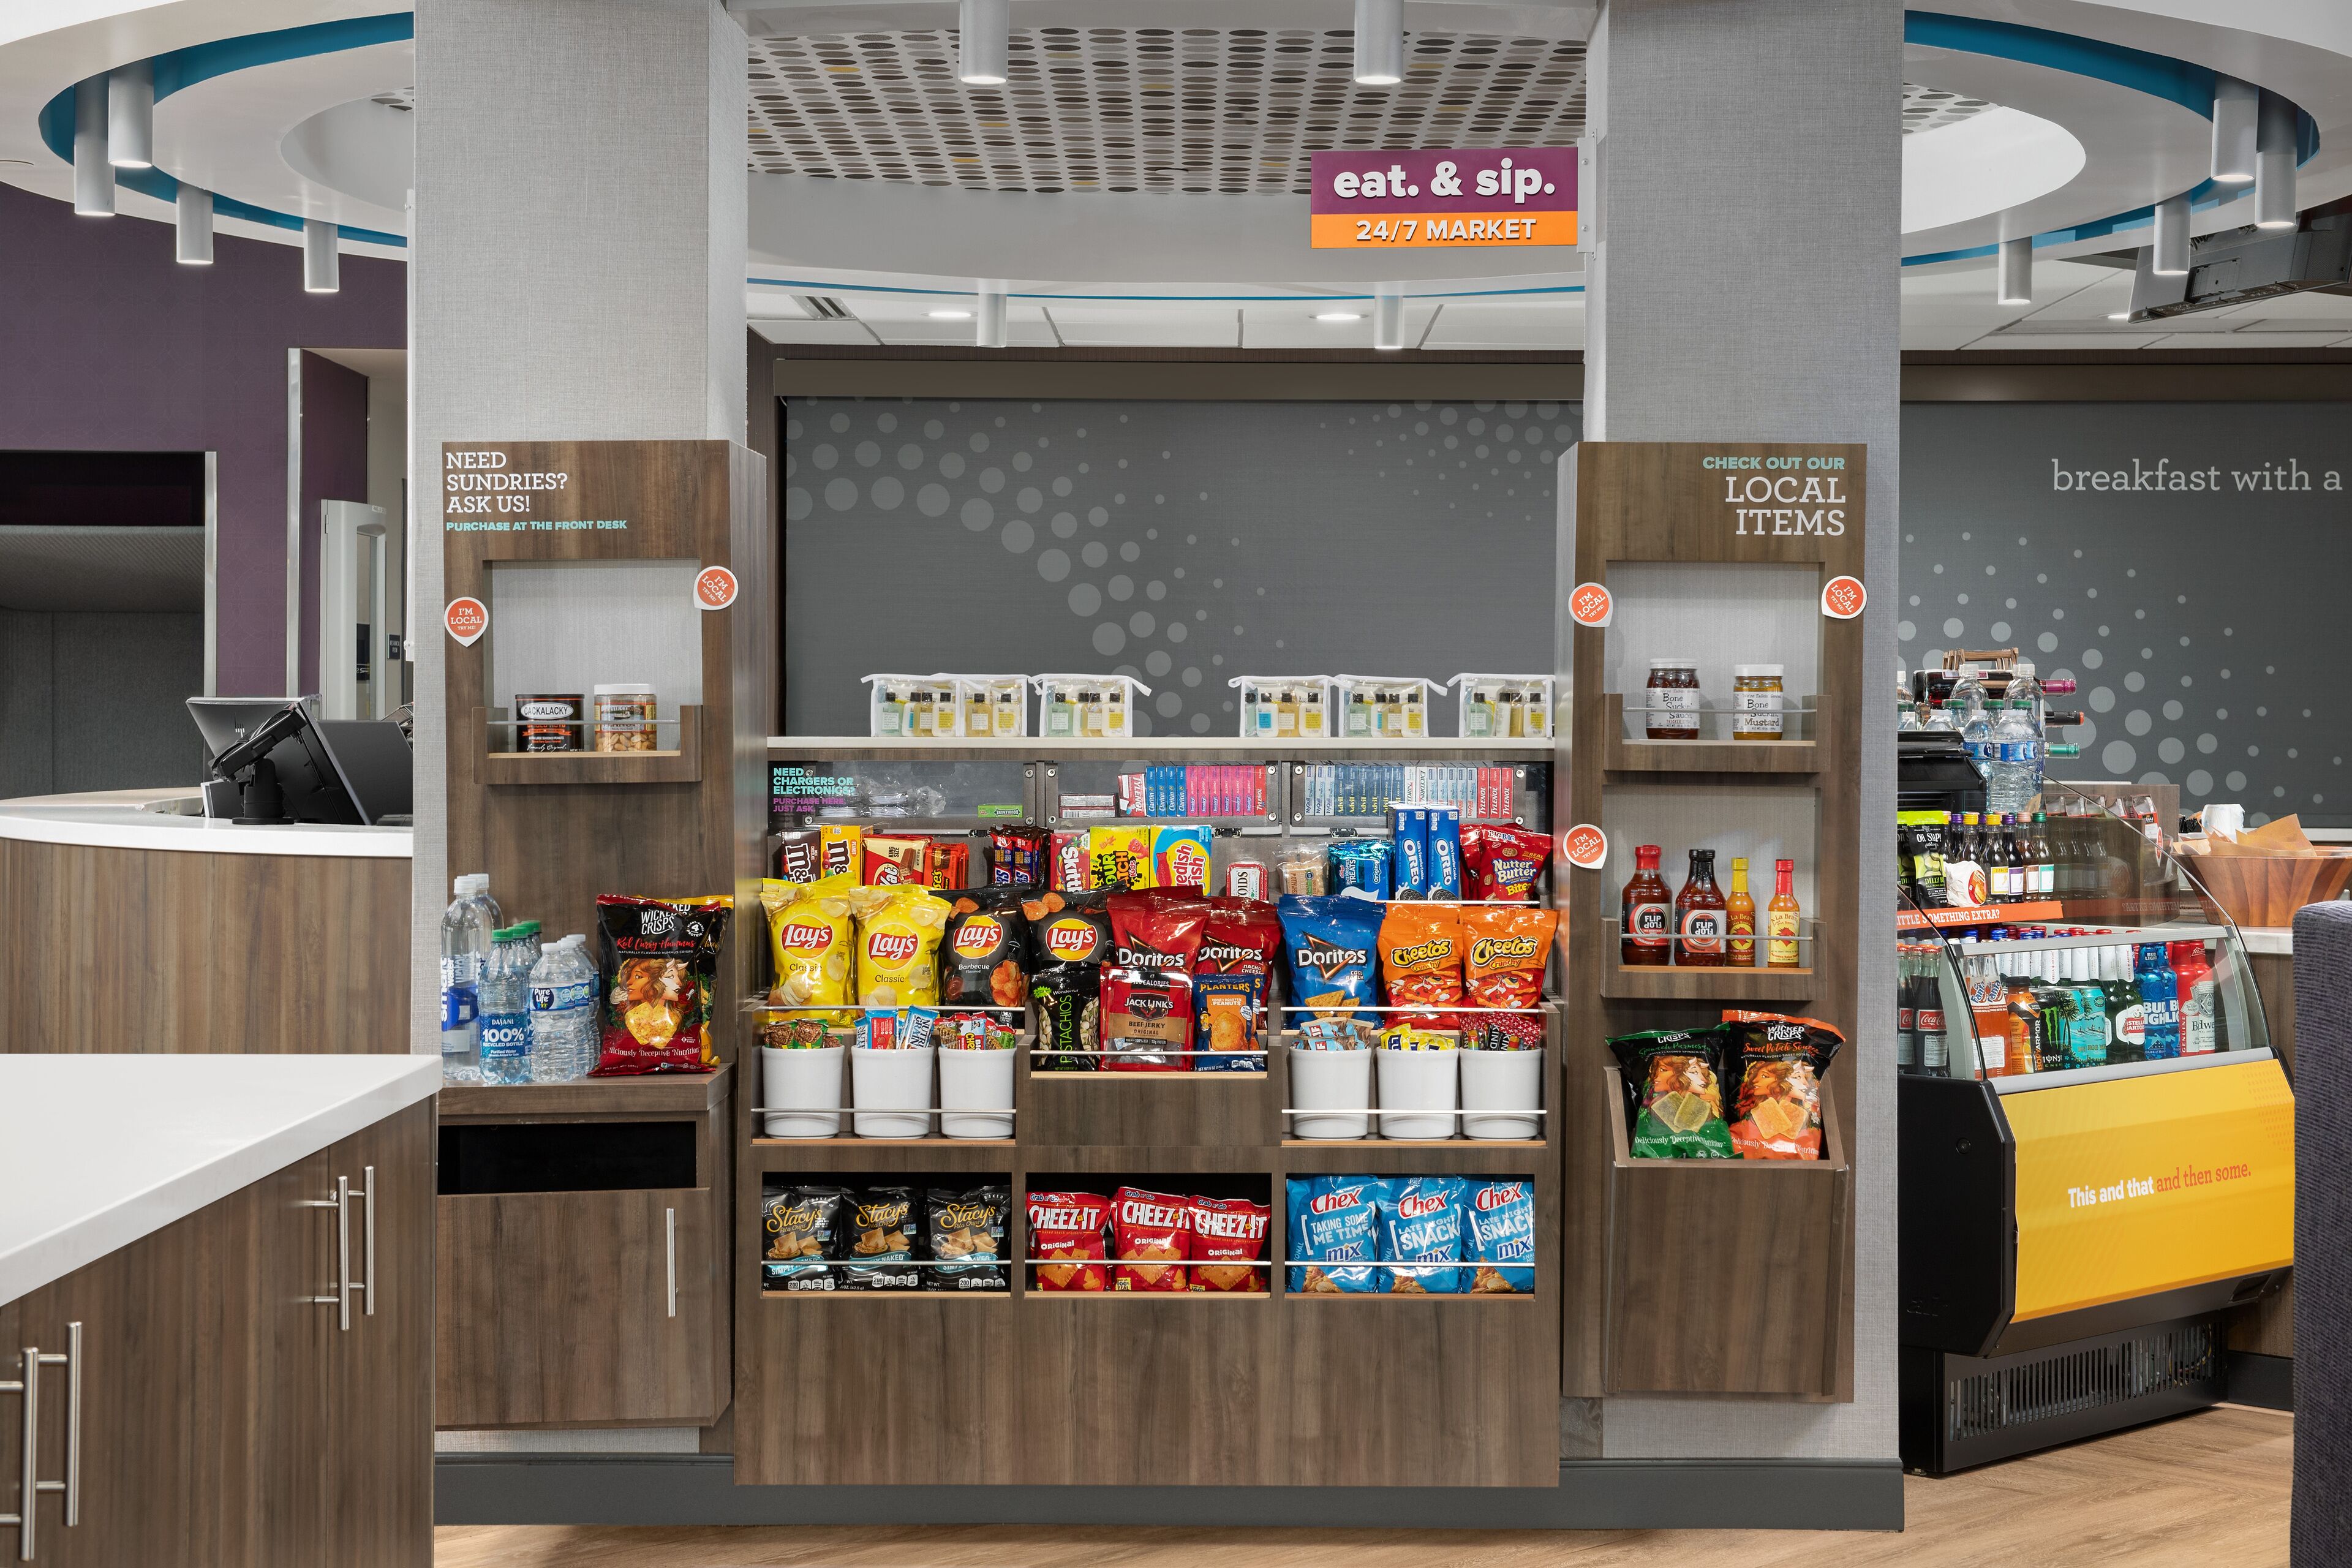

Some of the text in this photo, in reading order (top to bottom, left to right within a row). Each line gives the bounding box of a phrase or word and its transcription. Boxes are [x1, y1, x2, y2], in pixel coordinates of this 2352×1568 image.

[1333, 157, 1555, 203] eat. & sip.
[1356, 218, 1536, 242] 24/7 MARKET
[446, 452, 507, 469] NEED
[1702, 457, 1845, 470] CHECK OUT OUR
[447, 472, 568, 491] SUNDRIES?
[2051, 458, 2342, 491] breakfast with a
[1725, 477, 1846, 503] LOCAL
[447, 495, 530, 513] ASK US!
[446, 520, 627, 531] PURCHASE AT THE FRONT DESK
[1736, 509, 1845, 536] ITEMS
[702, 575, 726, 602] LOCAL
[1577, 594, 1606, 617] LOCAL
[1831, 584, 1854, 612] LOCAL
[1663, 693, 1683, 702] Bone
[1747, 699, 1769, 708] Bone
[524, 706, 568, 715] CACKALACKY
[774, 767, 804, 776] NEED
[773, 777, 854, 785] CHARGERS OR
[773, 786, 856, 795] ELECTRONICS?
[1133, 775, 1143, 812] TYLENOL
[1502, 833, 1516, 842] BAG
[1917, 834, 1925, 843] OH
[1572, 836, 1601, 858] LOCAL
[1129, 860, 1137, 877] Kids
[1402, 839, 1419, 886] OREO
[1434, 839, 1452, 886] OREO
[1493, 859, 1533, 873] Nutter
[1498, 867, 1537, 883] Butter
[1922, 909, 2000, 923] SOMETHING EXTRA?
[641, 916, 675, 935] CRISPS
[956, 921, 1001, 946] Lay's
[617, 937, 695, 952] Red Curry Hummus
[785, 925, 830, 949] Lay's
[1051, 928, 1094, 951] Lay's
[872, 933, 916, 960] Lay's
[1197, 948, 1262, 962] Doritos
[1392, 939, 1451, 967] Cheetos
[1472, 937, 1539, 967] Cheetos
[1118, 949, 1186, 967] Doritos
[1298, 948, 1366, 966] Doritos
[1411, 960, 1440, 972] Crunchy
[1489, 959, 1520, 970] Crunchy
[875, 974, 905, 984] Classic
[1200, 984, 1250, 993] PLANTERS
[1125, 998, 1147, 1008] JACK
[483, 1028, 524, 1041] 100%
[1657, 1031, 1692, 1043] CRISPS
[1767, 1025, 1804, 1035] WICKED
[1767, 1030, 1804, 1041] CRISPS
[672, 1047, 700, 1056] Nutrition
[1743, 1042, 1765, 1054] Sweet
[1670, 1136, 1702, 1144] Deceptive
[2068, 1164, 2252, 1208] This and that and then some.
[1311, 1188, 1359, 1215] Chex
[1400, 1191, 1448, 1219] Chex
[1476, 1185, 1522, 1210] Chex
[766, 1205, 823, 1232] Stacy's
[856, 1203, 908, 1228] Stacy's
[941, 1204, 996, 1230] Stacy's
[1310, 1213, 1368, 1234] TAKING SOME
[1479, 1205, 1533, 1224] LATE NIGHT
[1313, 1223, 1368, 1246] ME TIME
[1399, 1224, 1420, 1235] LATE
[1401, 1224, 1461, 1250] SNACK
[1499, 1241, 1532, 1261] mix
